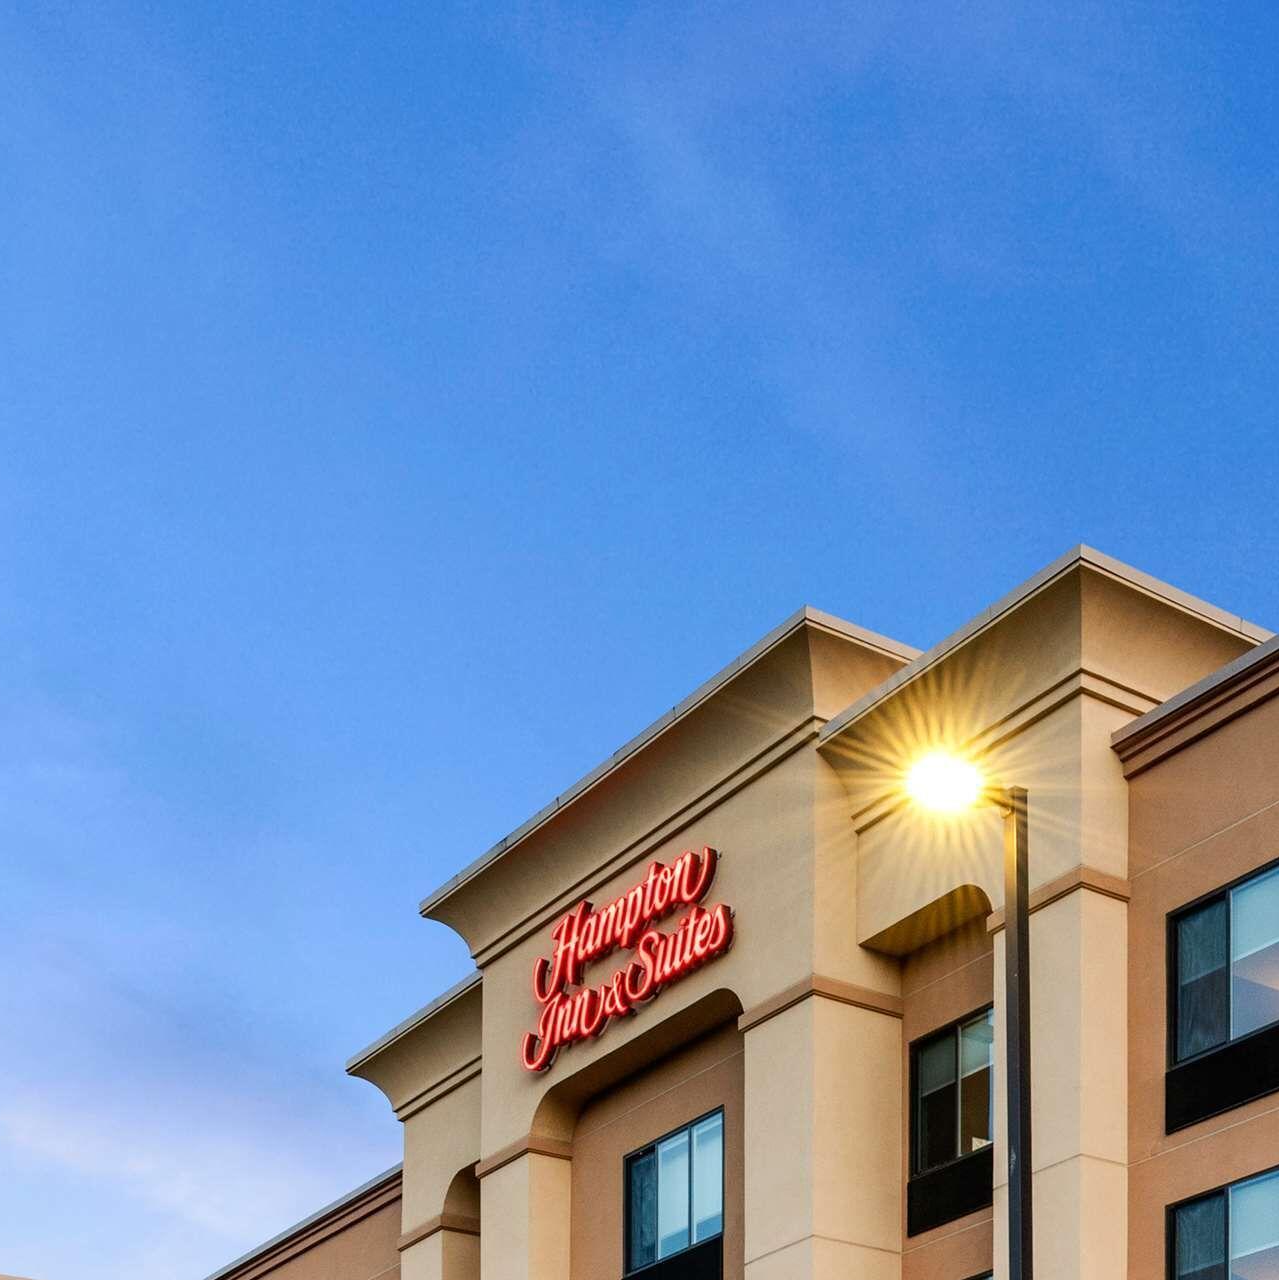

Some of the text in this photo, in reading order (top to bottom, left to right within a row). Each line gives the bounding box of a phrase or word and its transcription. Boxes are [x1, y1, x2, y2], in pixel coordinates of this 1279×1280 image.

[522, 903, 734, 1072] Inn & Suites
[534, 847, 719, 1004] Hampton
